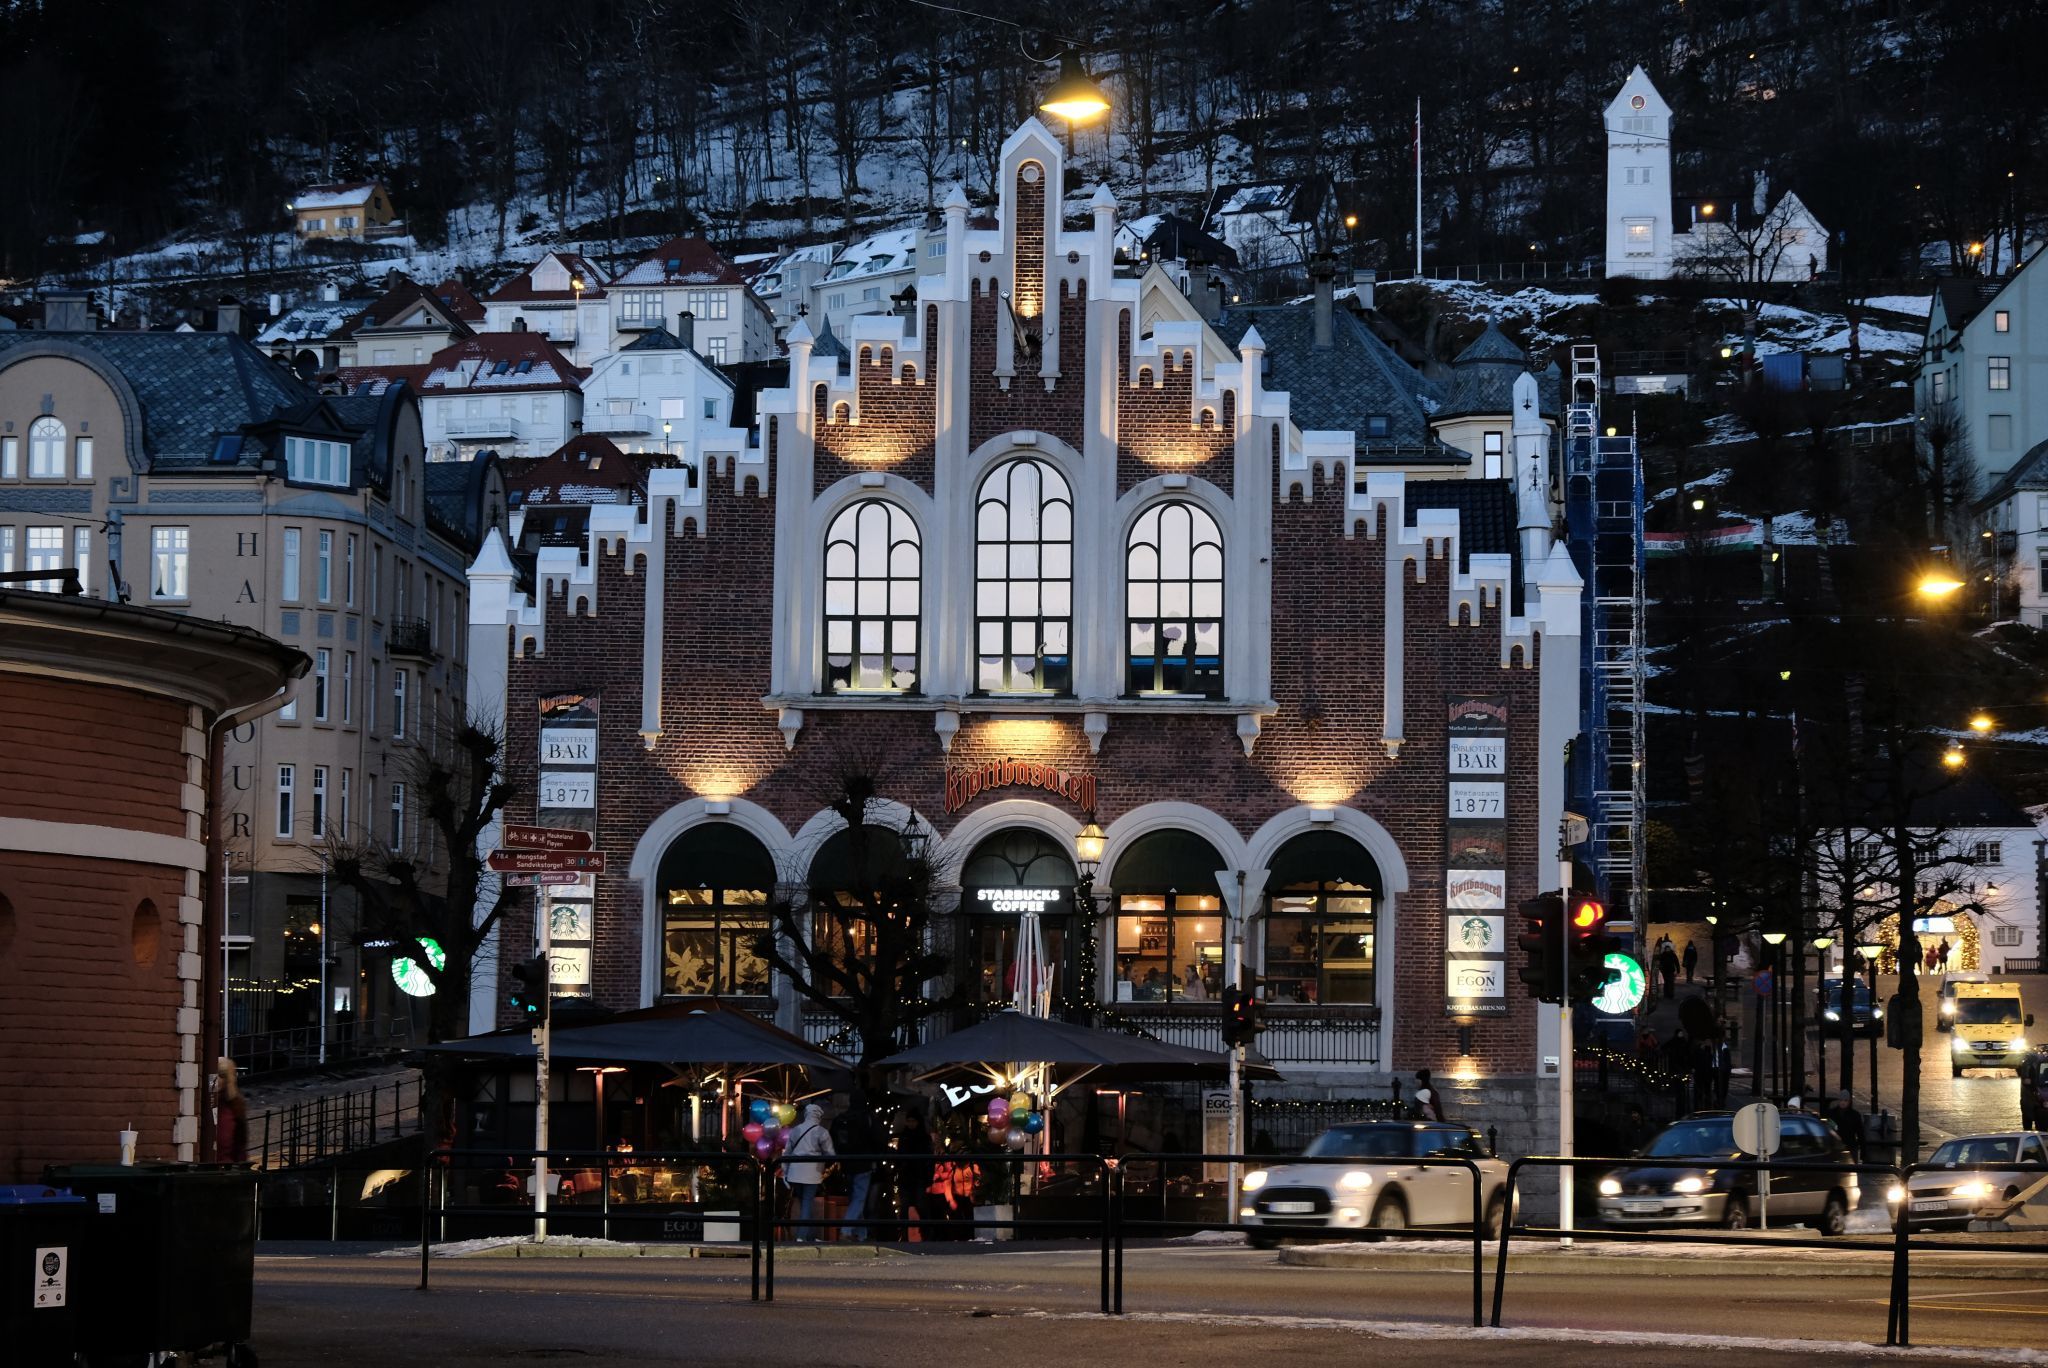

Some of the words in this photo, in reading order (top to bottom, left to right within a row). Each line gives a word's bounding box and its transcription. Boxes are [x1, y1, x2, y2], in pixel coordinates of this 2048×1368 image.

[549, 743, 588, 759] BAR
[1458, 753, 1498, 768] BAR
[546, 788, 590, 802] 1877
[1455, 798, 1499, 813] 1877
[516, 853, 548, 861] Mongstad
[516, 861, 563, 869] Sandvikstorget
[977, 889, 1060, 901] STARBUCKS
[992, 901, 1045, 912] COFFEE
[551, 963, 582, 974] GON
[1457, 976, 1496, 987] EGON
[1206, 1099, 1230, 1109] EGO
